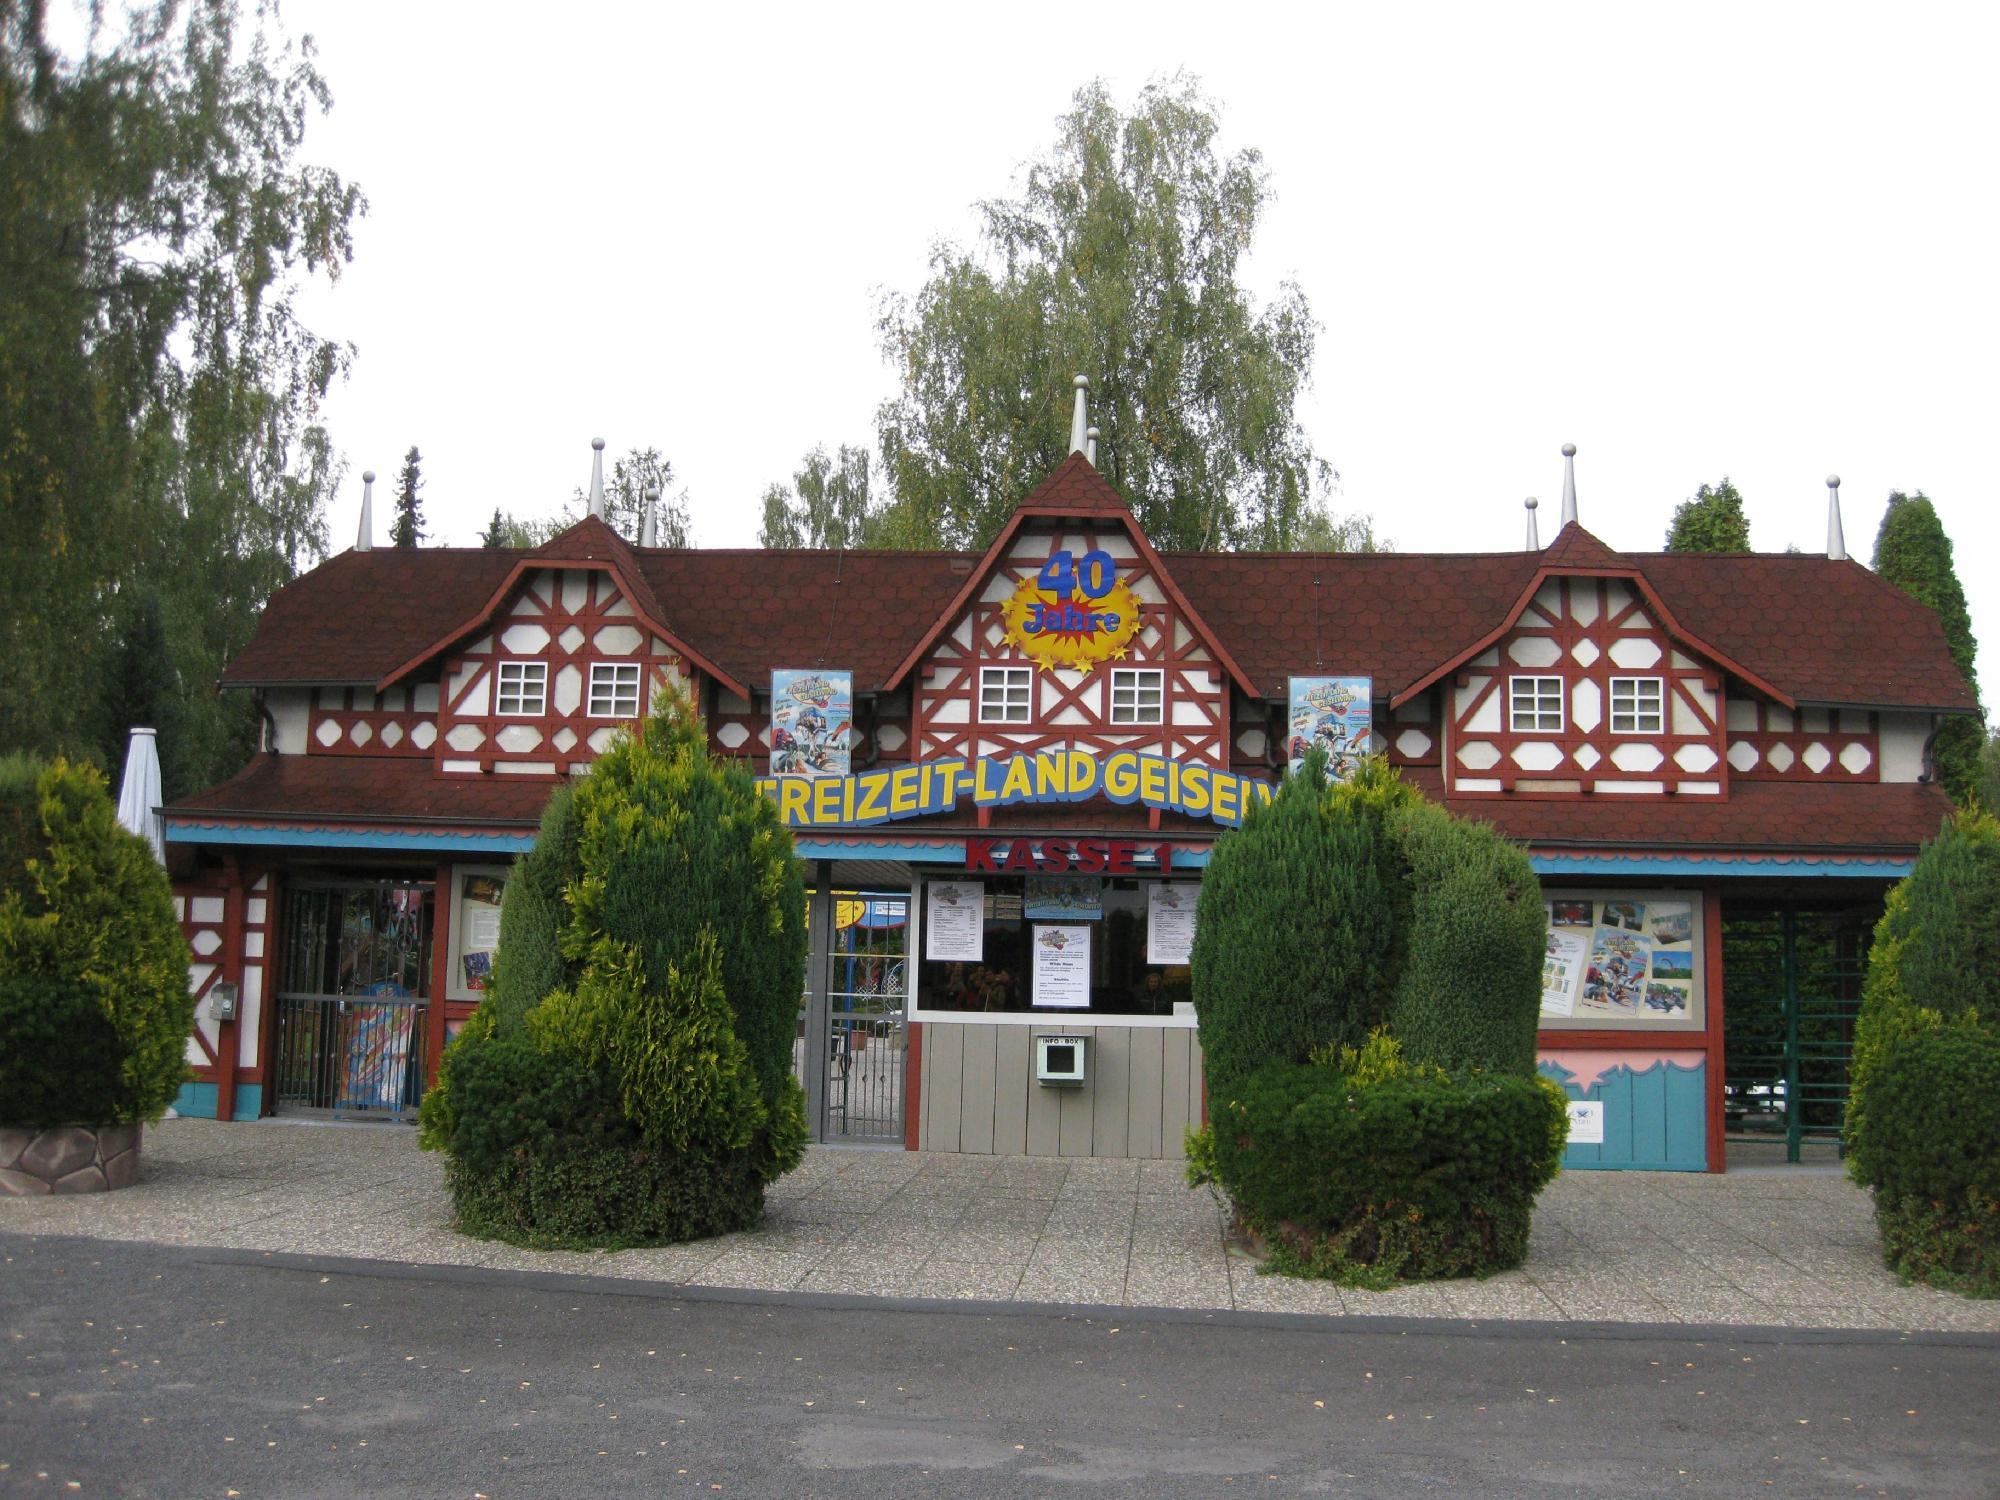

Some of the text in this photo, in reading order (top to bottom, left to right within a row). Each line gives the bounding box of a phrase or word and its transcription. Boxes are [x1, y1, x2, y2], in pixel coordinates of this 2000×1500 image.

[1037, 550, 1116, 599] 40
[1022, 603, 1121, 633] Jahre
[966, 837, 1172, 875] KASSE 1
